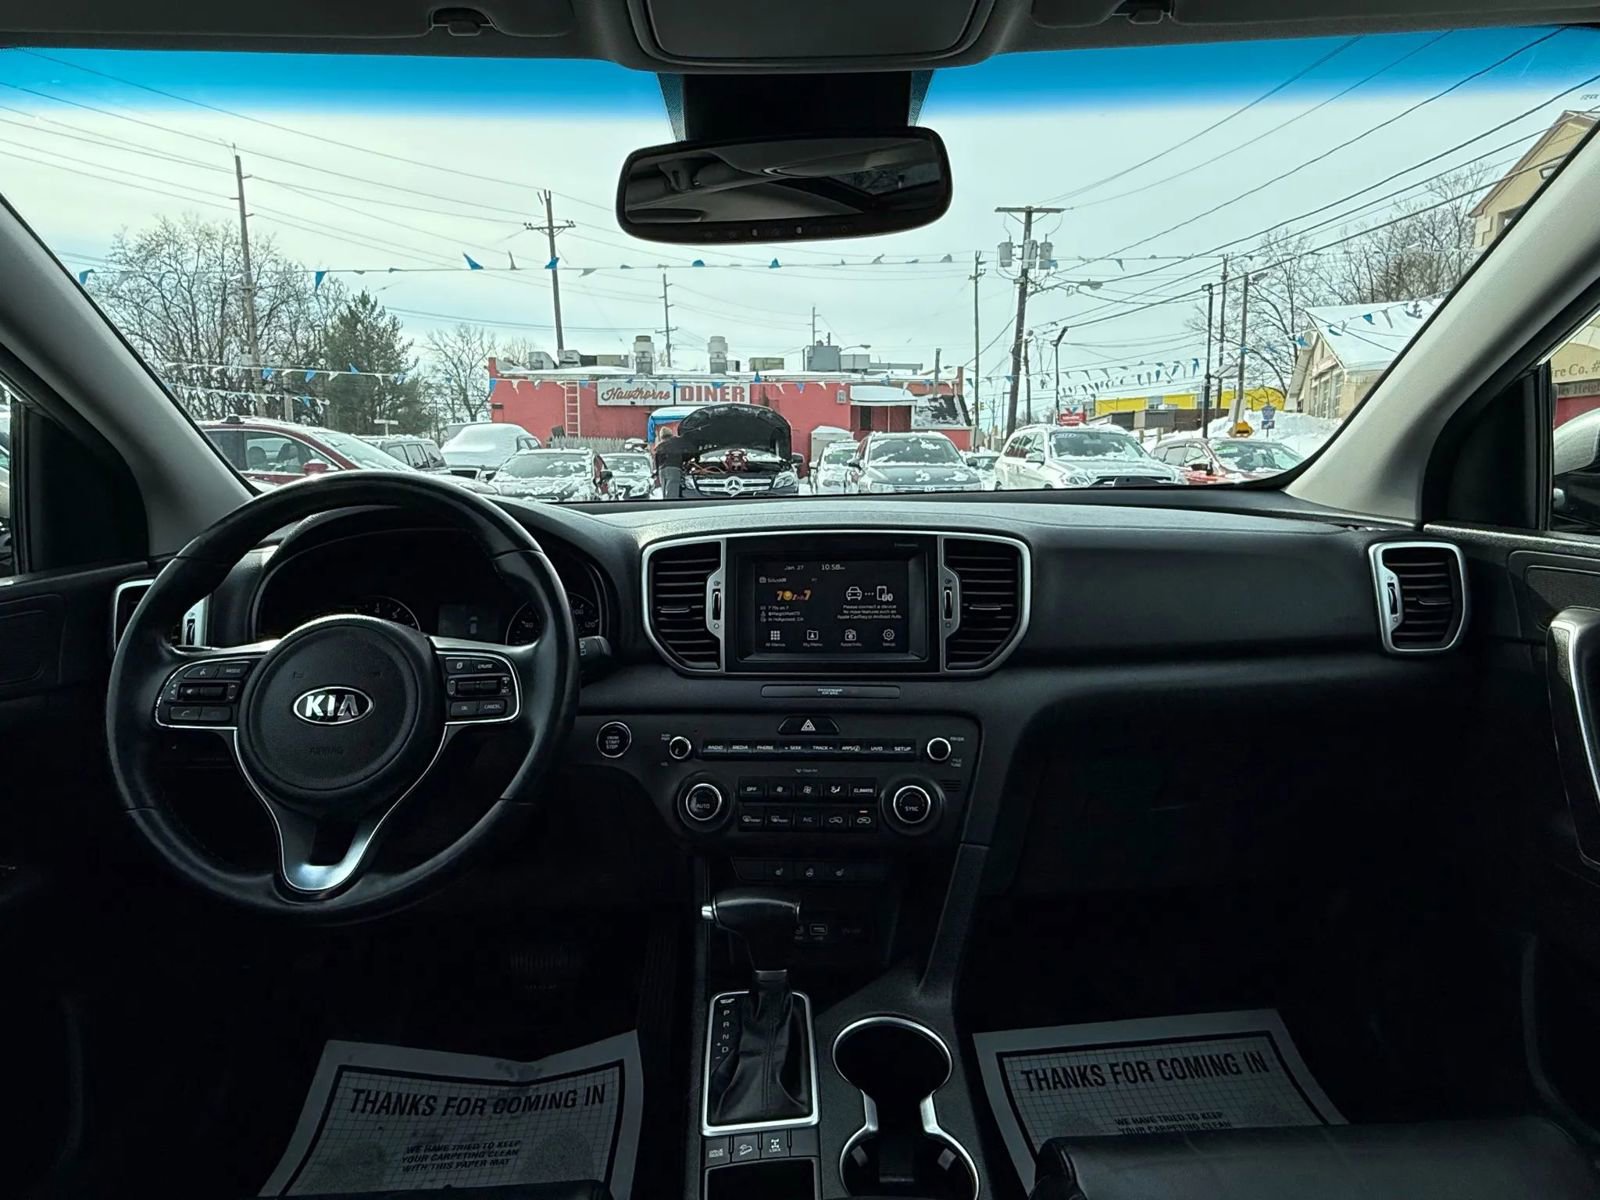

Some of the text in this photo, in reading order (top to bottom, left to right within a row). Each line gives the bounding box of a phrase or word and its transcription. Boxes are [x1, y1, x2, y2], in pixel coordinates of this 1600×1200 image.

[601, 385, 745, 402] Hawthorne DINER
[305, 694, 359, 717] KIA
[1021, 1050, 1270, 1091] THANKS FOR COMING IN
[350, 1084, 605, 1117] THANKS FOR COMING IN
[1114, 1111, 1224, 1126] WE HAVE TRIED TO KEEP
[402, 1149, 519, 1163] YOUR CARPETING CLEAN
[406, 1144, 423, 1154] WE
[424, 1143, 450, 1153] HAVE
[452, 1143, 480, 1152] TRIED
[482, 1142, 494, 1150] TO
[402, 1158, 511, 1172] WITH THIS PAPER MAT
